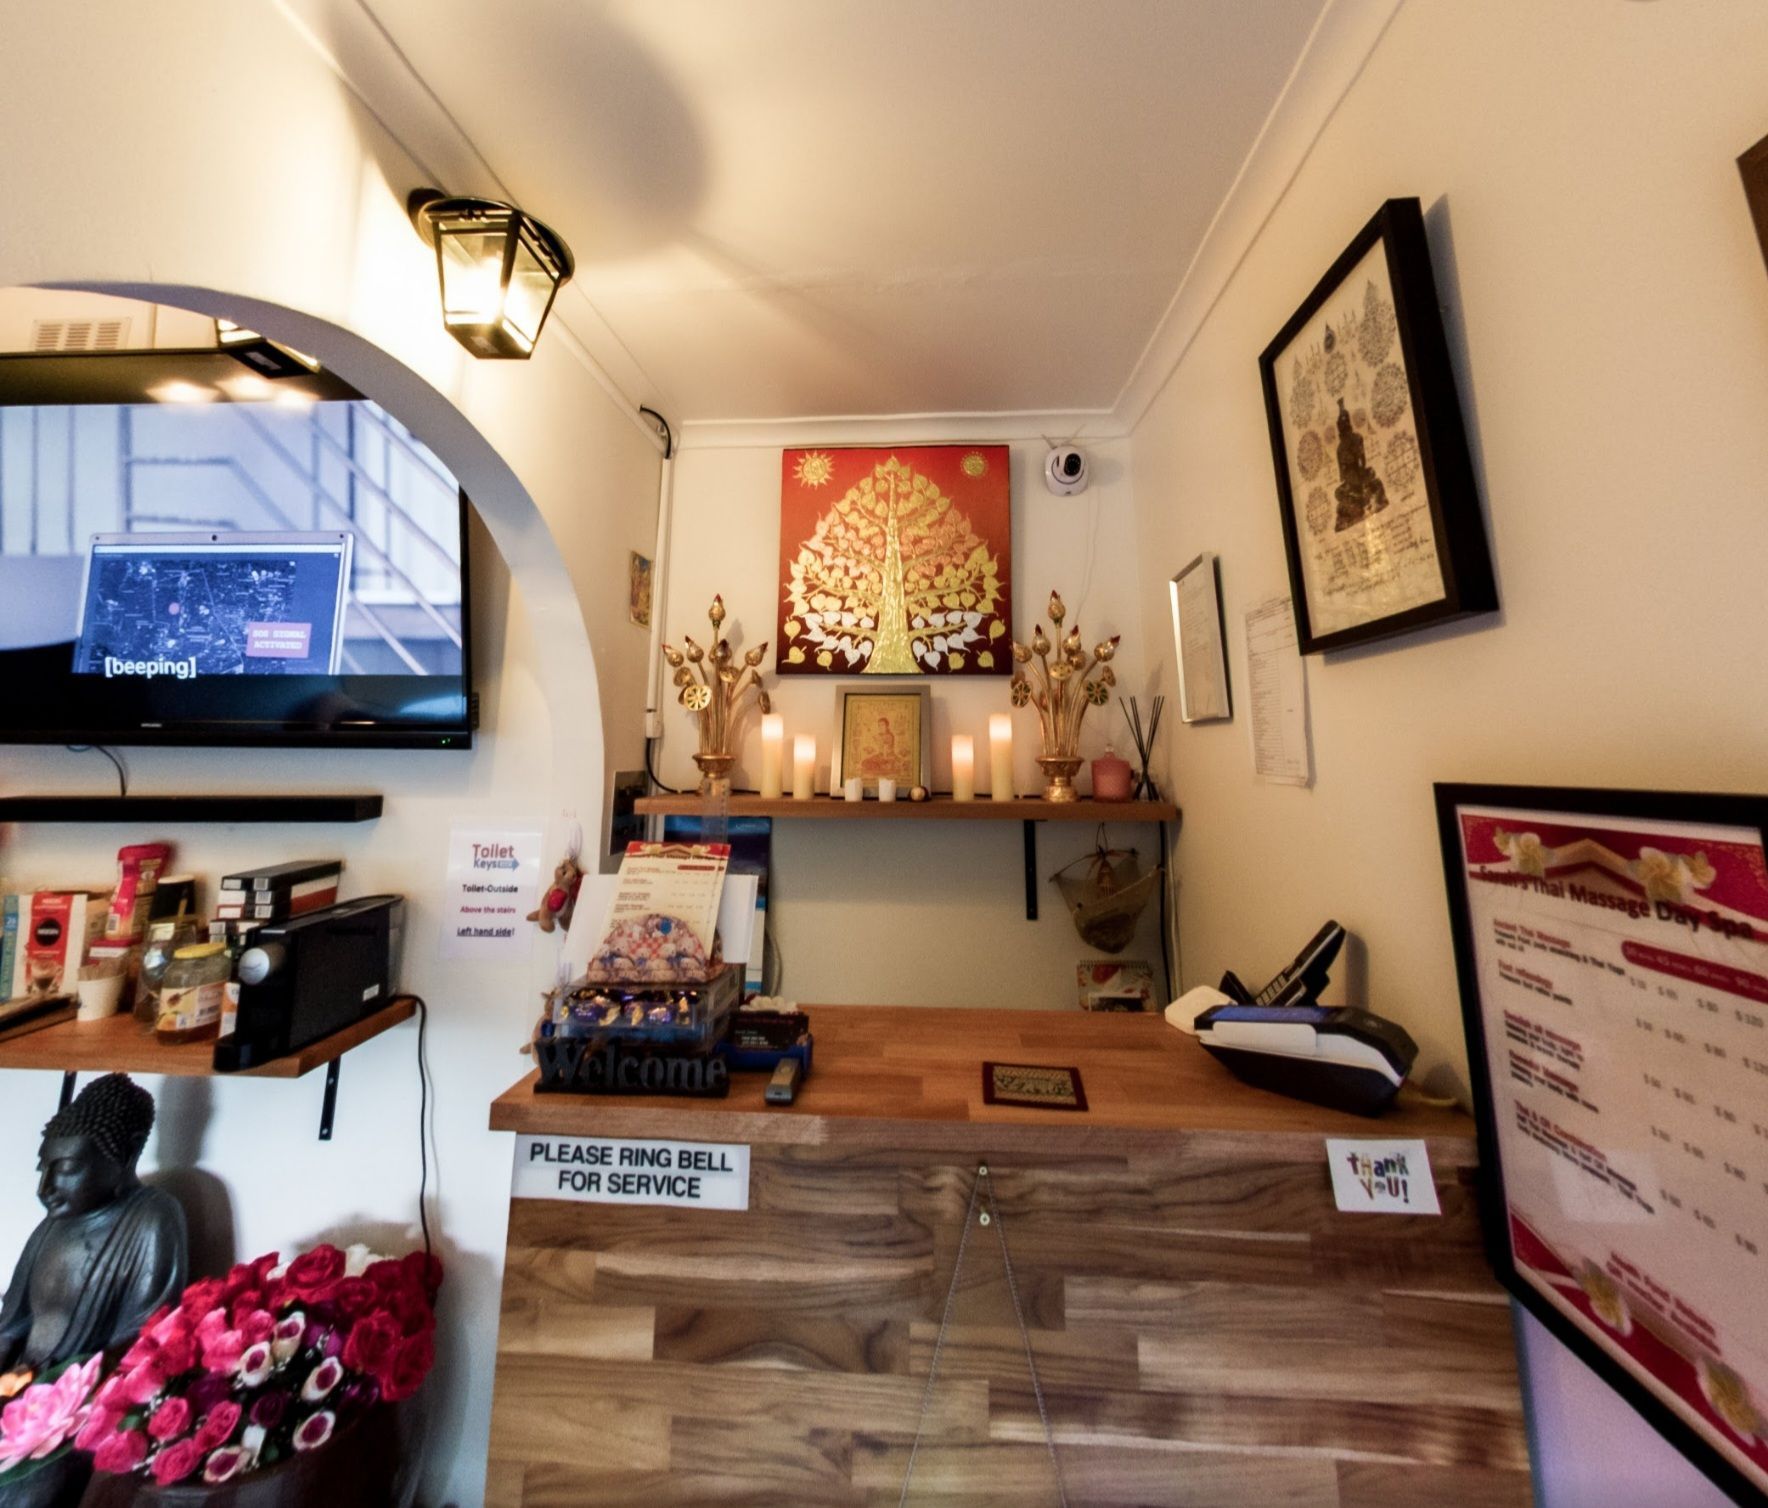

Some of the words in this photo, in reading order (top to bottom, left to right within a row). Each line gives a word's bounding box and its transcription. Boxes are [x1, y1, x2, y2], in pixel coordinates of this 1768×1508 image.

[105, 656, 196, 679] [beeping]
[472, 844, 515, 859] Toilet
[473, 859, 497, 870] Keys
[483, 906, 495, 914] the
[1532, 878, 1565, 899] Thai
[1568, 883, 1651, 920] Massage
[1655, 898, 1700, 933] Day
[1704, 909, 1754, 941] Spa
[456, 927, 472, 937] Left
[535, 1035, 729, 1090] Welcome
[530, 1142, 613, 1167] PLEASE
[618, 1147, 672, 1168] RING
[677, 1150, 733, 1172] BELL
[558, 1169, 601, 1193] FOR
[607, 1172, 701, 1199] SERVICE
